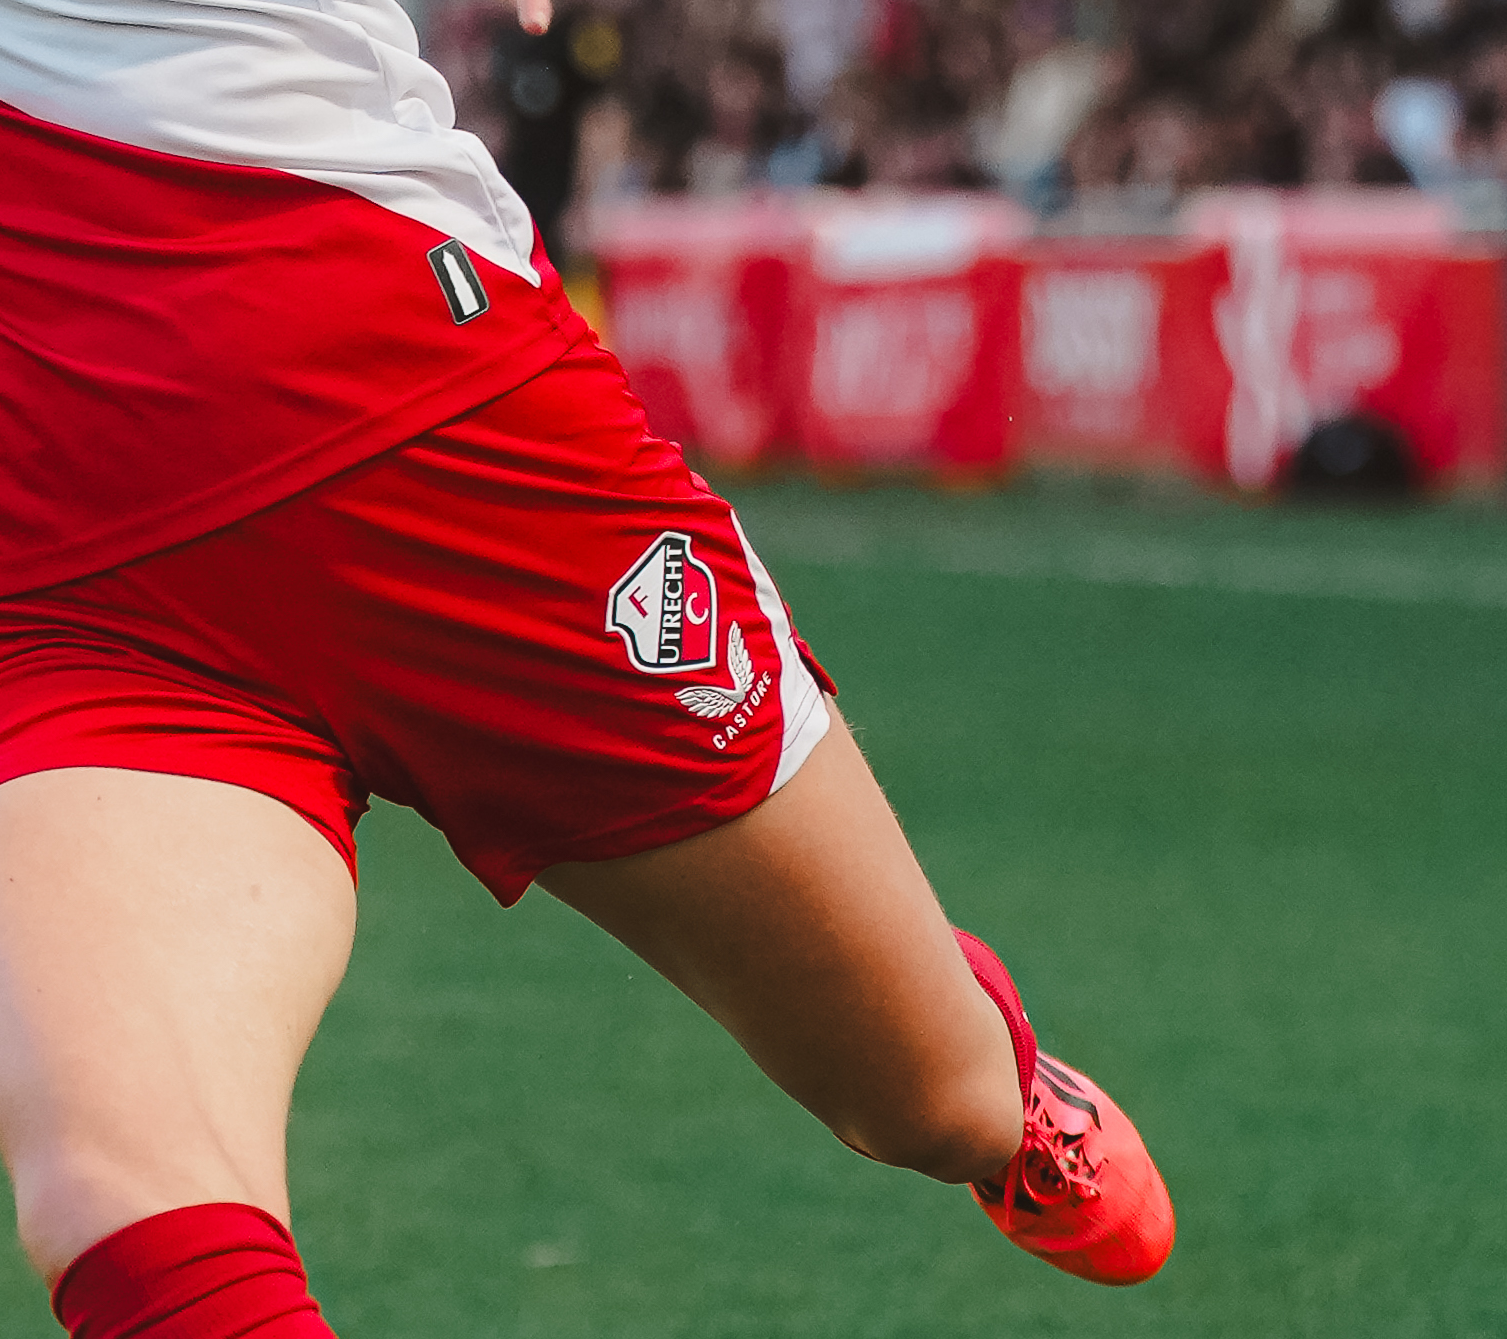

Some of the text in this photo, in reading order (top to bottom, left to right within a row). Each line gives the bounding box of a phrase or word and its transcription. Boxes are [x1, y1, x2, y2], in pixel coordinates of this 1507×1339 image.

[628, 586, 648, 618] F
[659, 544, 684, 664] UTRECHT
[685, 592, 709, 625] C
[712, 671, 773, 751] CASTORE
